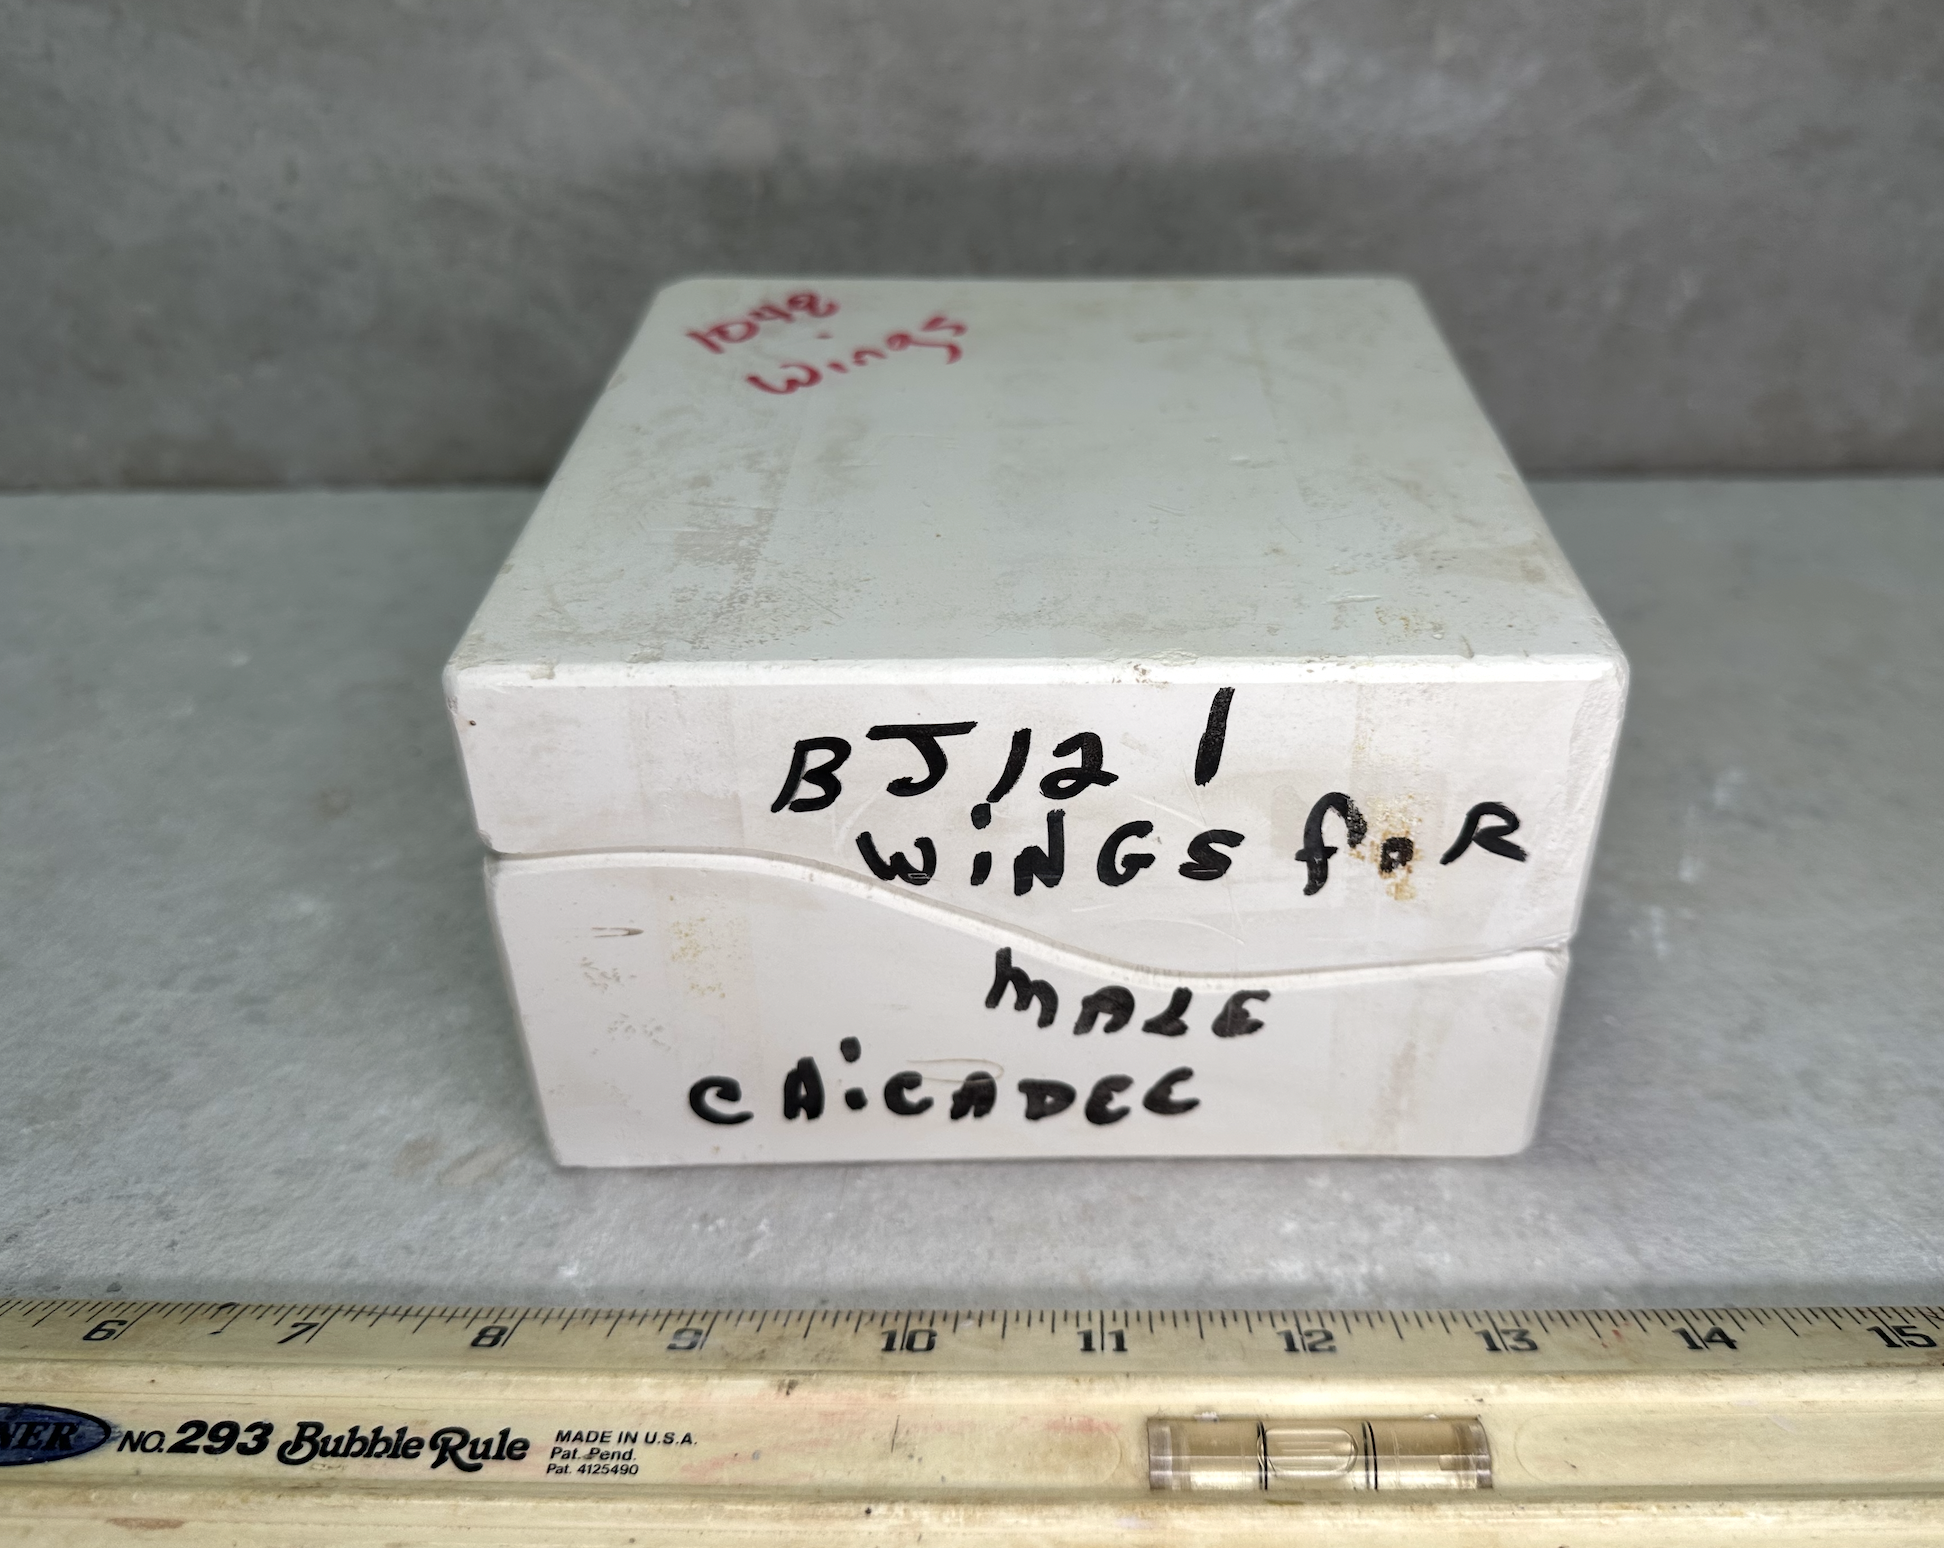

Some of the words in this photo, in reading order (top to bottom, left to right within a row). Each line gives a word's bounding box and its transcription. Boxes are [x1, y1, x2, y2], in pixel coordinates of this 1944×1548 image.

[82, 1319, 127, 1342] 6
[277, 1322, 318, 1345] 7
[470, 1325, 509, 1349] 8
[666, 1327, 704, 1351] 9
[880, 1328, 938, 1352] 10
[1076, 1328, 1129, 1353] 11
[1276, 1328, 1337, 1353] 12
[1474, 1328, 1539, 1352] 13
[1671, 1325, 1738, 1350] 14
[1865, 1324, 1938, 1349] 15
[555, 1430, 612, 1443] MADE
[617, 1431, 639, 1443] IN
[644, 1431, 698, 1445] U.S.A.
[117, 1429, 165, 1454] NO.
[167, 1420, 274, 1456] 293
[276, 1421, 422, 1465] Bubble
[429, 1427, 531, 1472] Rule
[550, 1447, 581, 1460] Pat.
[587, 1447, 637, 1461] Pend.
[545, 1463, 573, 1475] Pat.
[576, 1464, 640, 1476] 4125490
